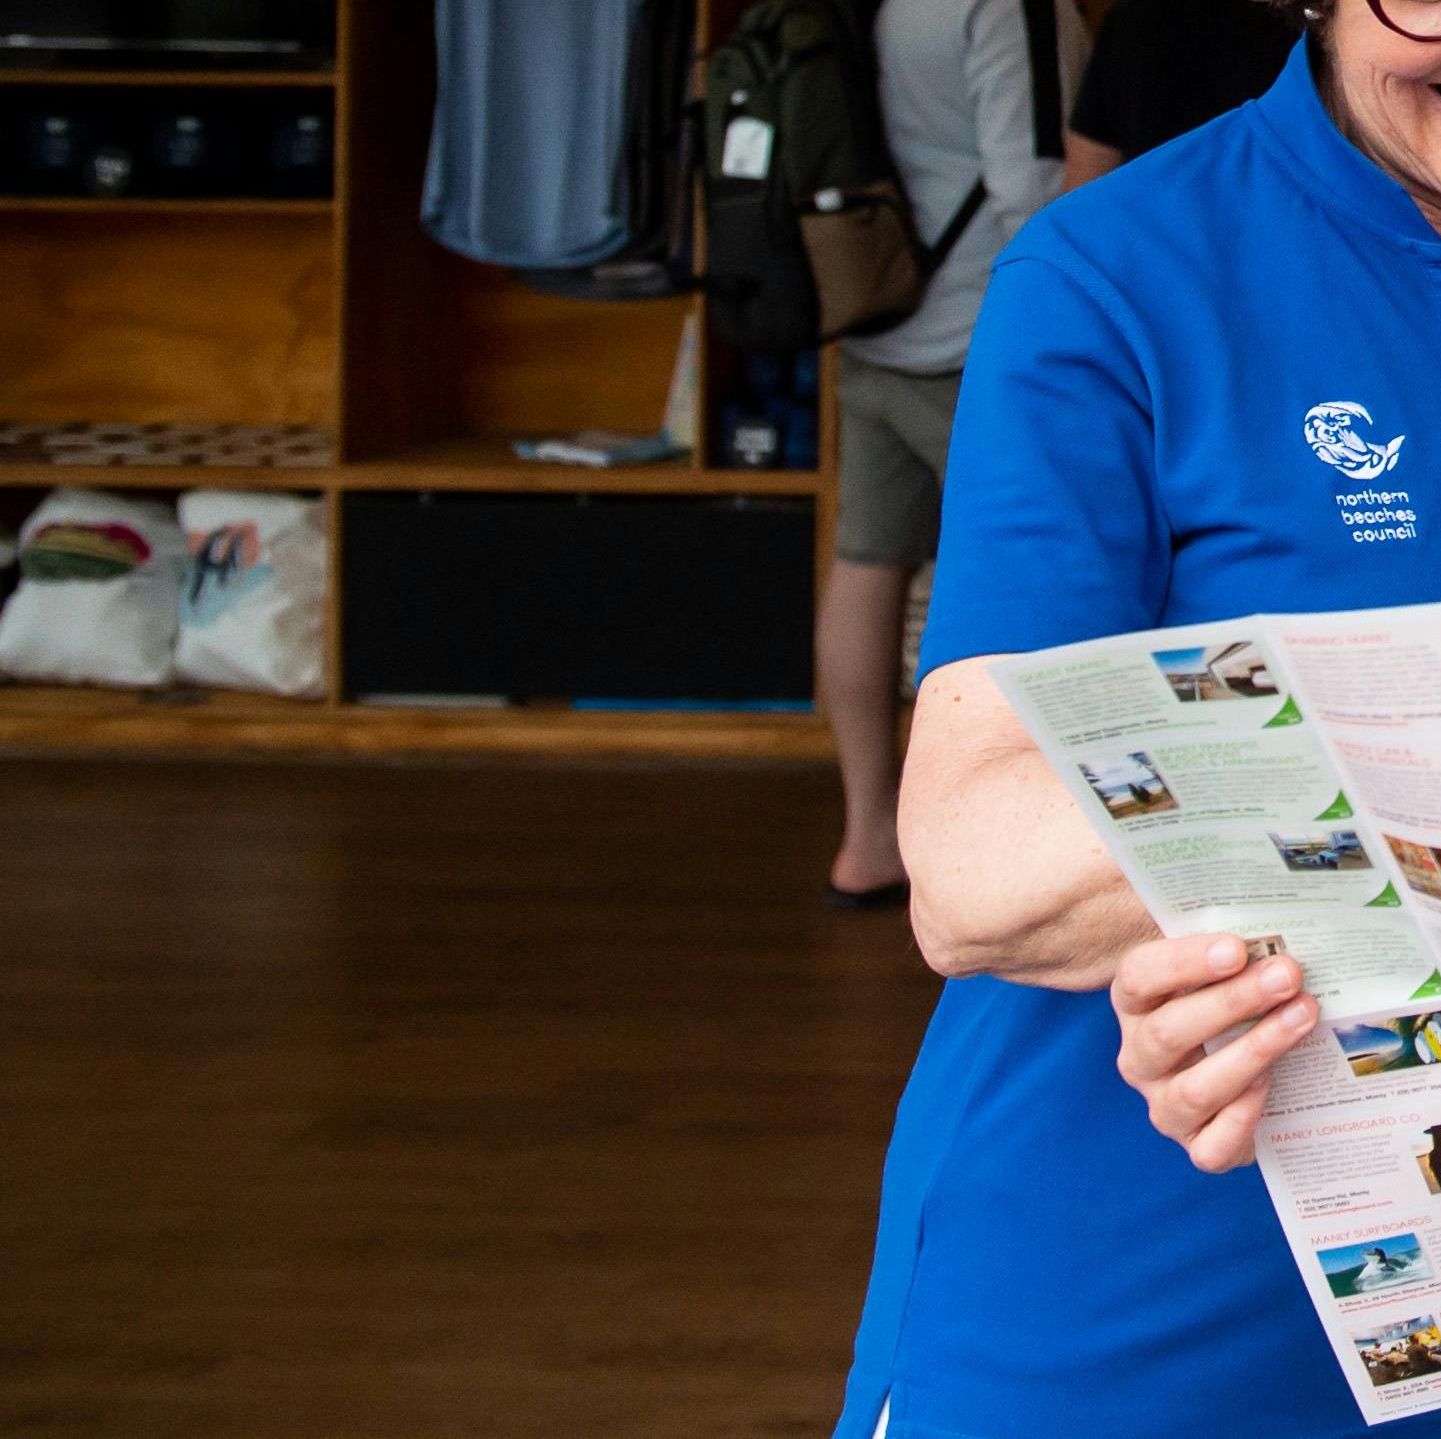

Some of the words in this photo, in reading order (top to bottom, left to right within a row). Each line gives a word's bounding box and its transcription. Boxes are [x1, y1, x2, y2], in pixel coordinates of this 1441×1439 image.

[1336, 490, 1409, 506] northern
[1342, 508, 1417, 525] beaches
[1352, 521, 1417, 542] council
[1271, 1129, 1312, 1143] MANLY
[1316, 1117, 1397, 1137] LONGBOARD
[1311, 1233, 1350, 1245] MANLY
[1353, 1215, 1433, 1239] SURFBOARDS
